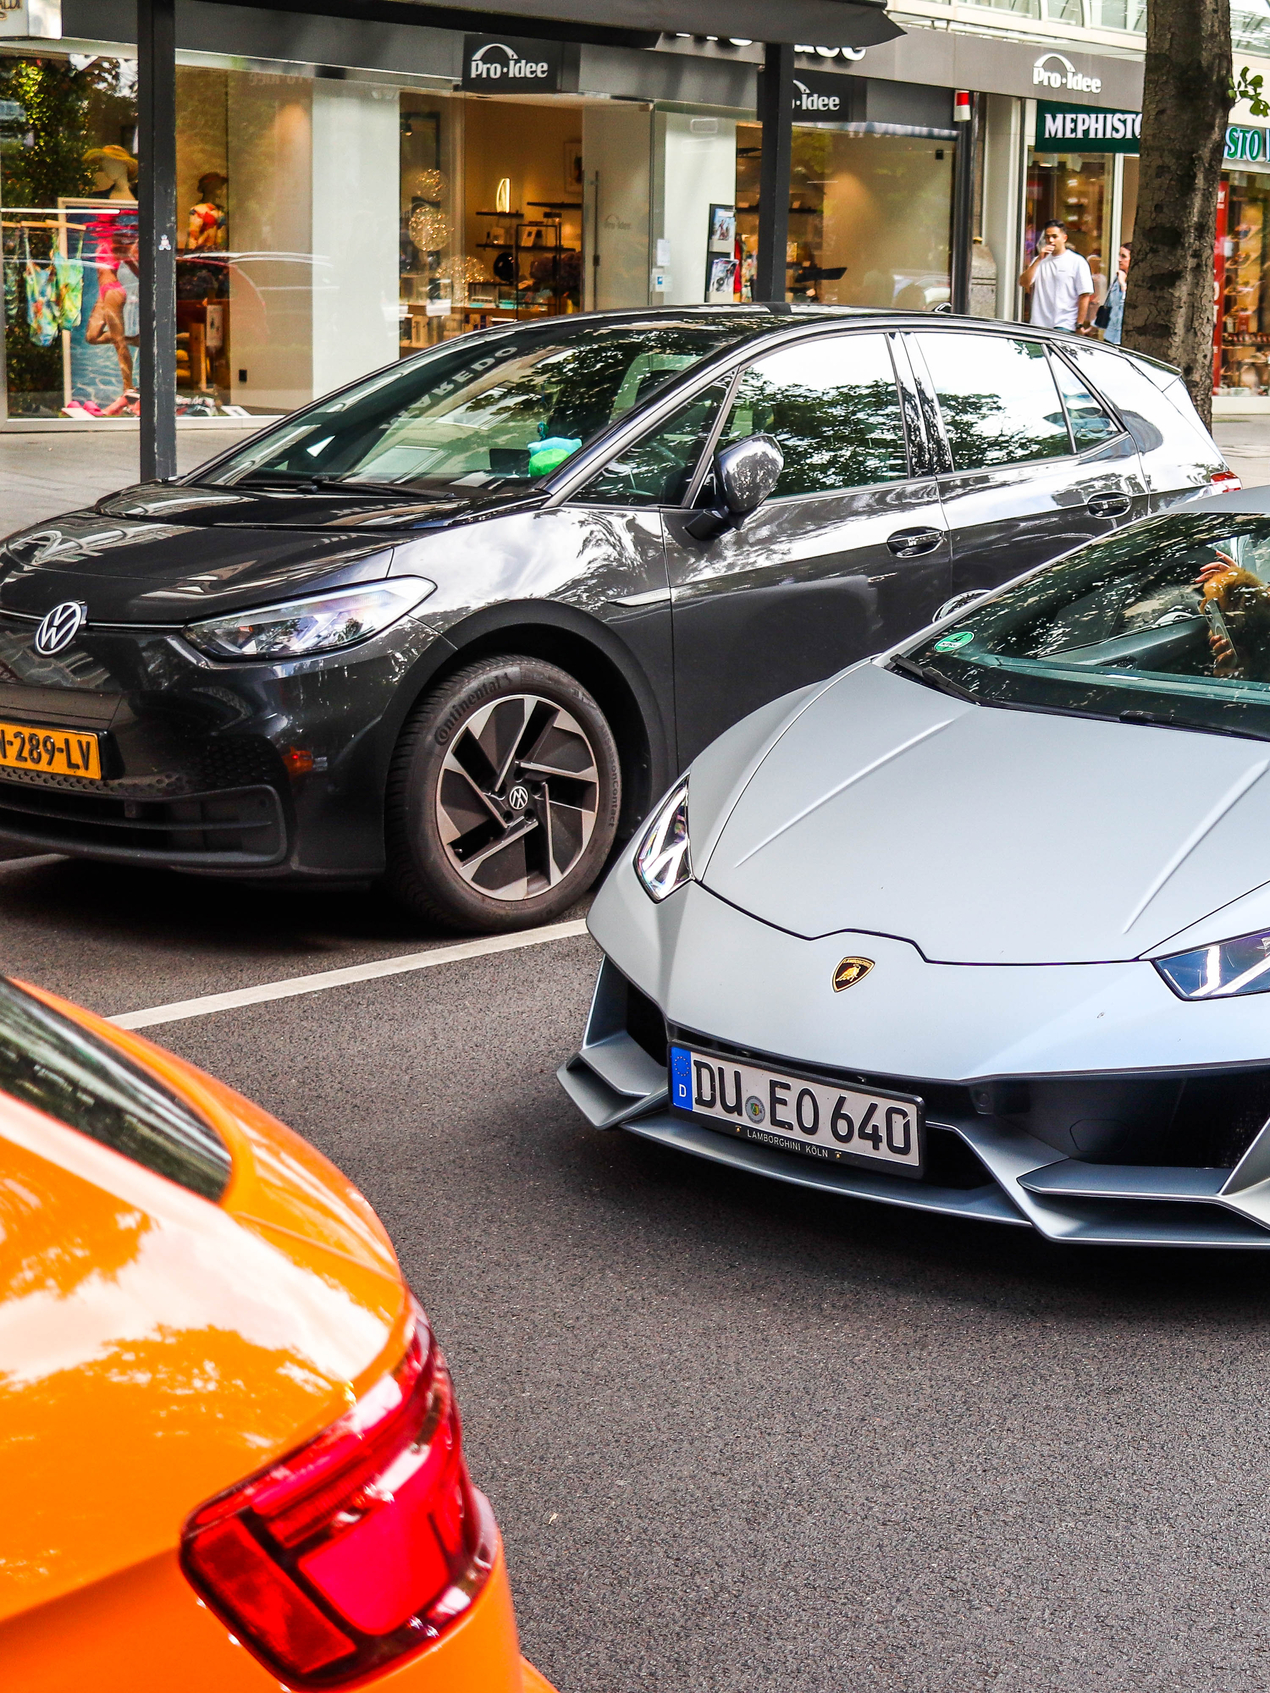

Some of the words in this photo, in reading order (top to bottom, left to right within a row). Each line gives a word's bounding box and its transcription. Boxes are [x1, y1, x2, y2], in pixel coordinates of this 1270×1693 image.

[435, 675, 503, 746] Continental
[679, 1083, 688, 1098] D
[693, 1059, 743, 1117] DU
[769, 1079, 819, 1136] EO
[830, 1094, 911, 1156] 640
[747, 1130, 801, 1152] LAMBORGHINI
[805, 1143, 829, 1159] KÖLN
